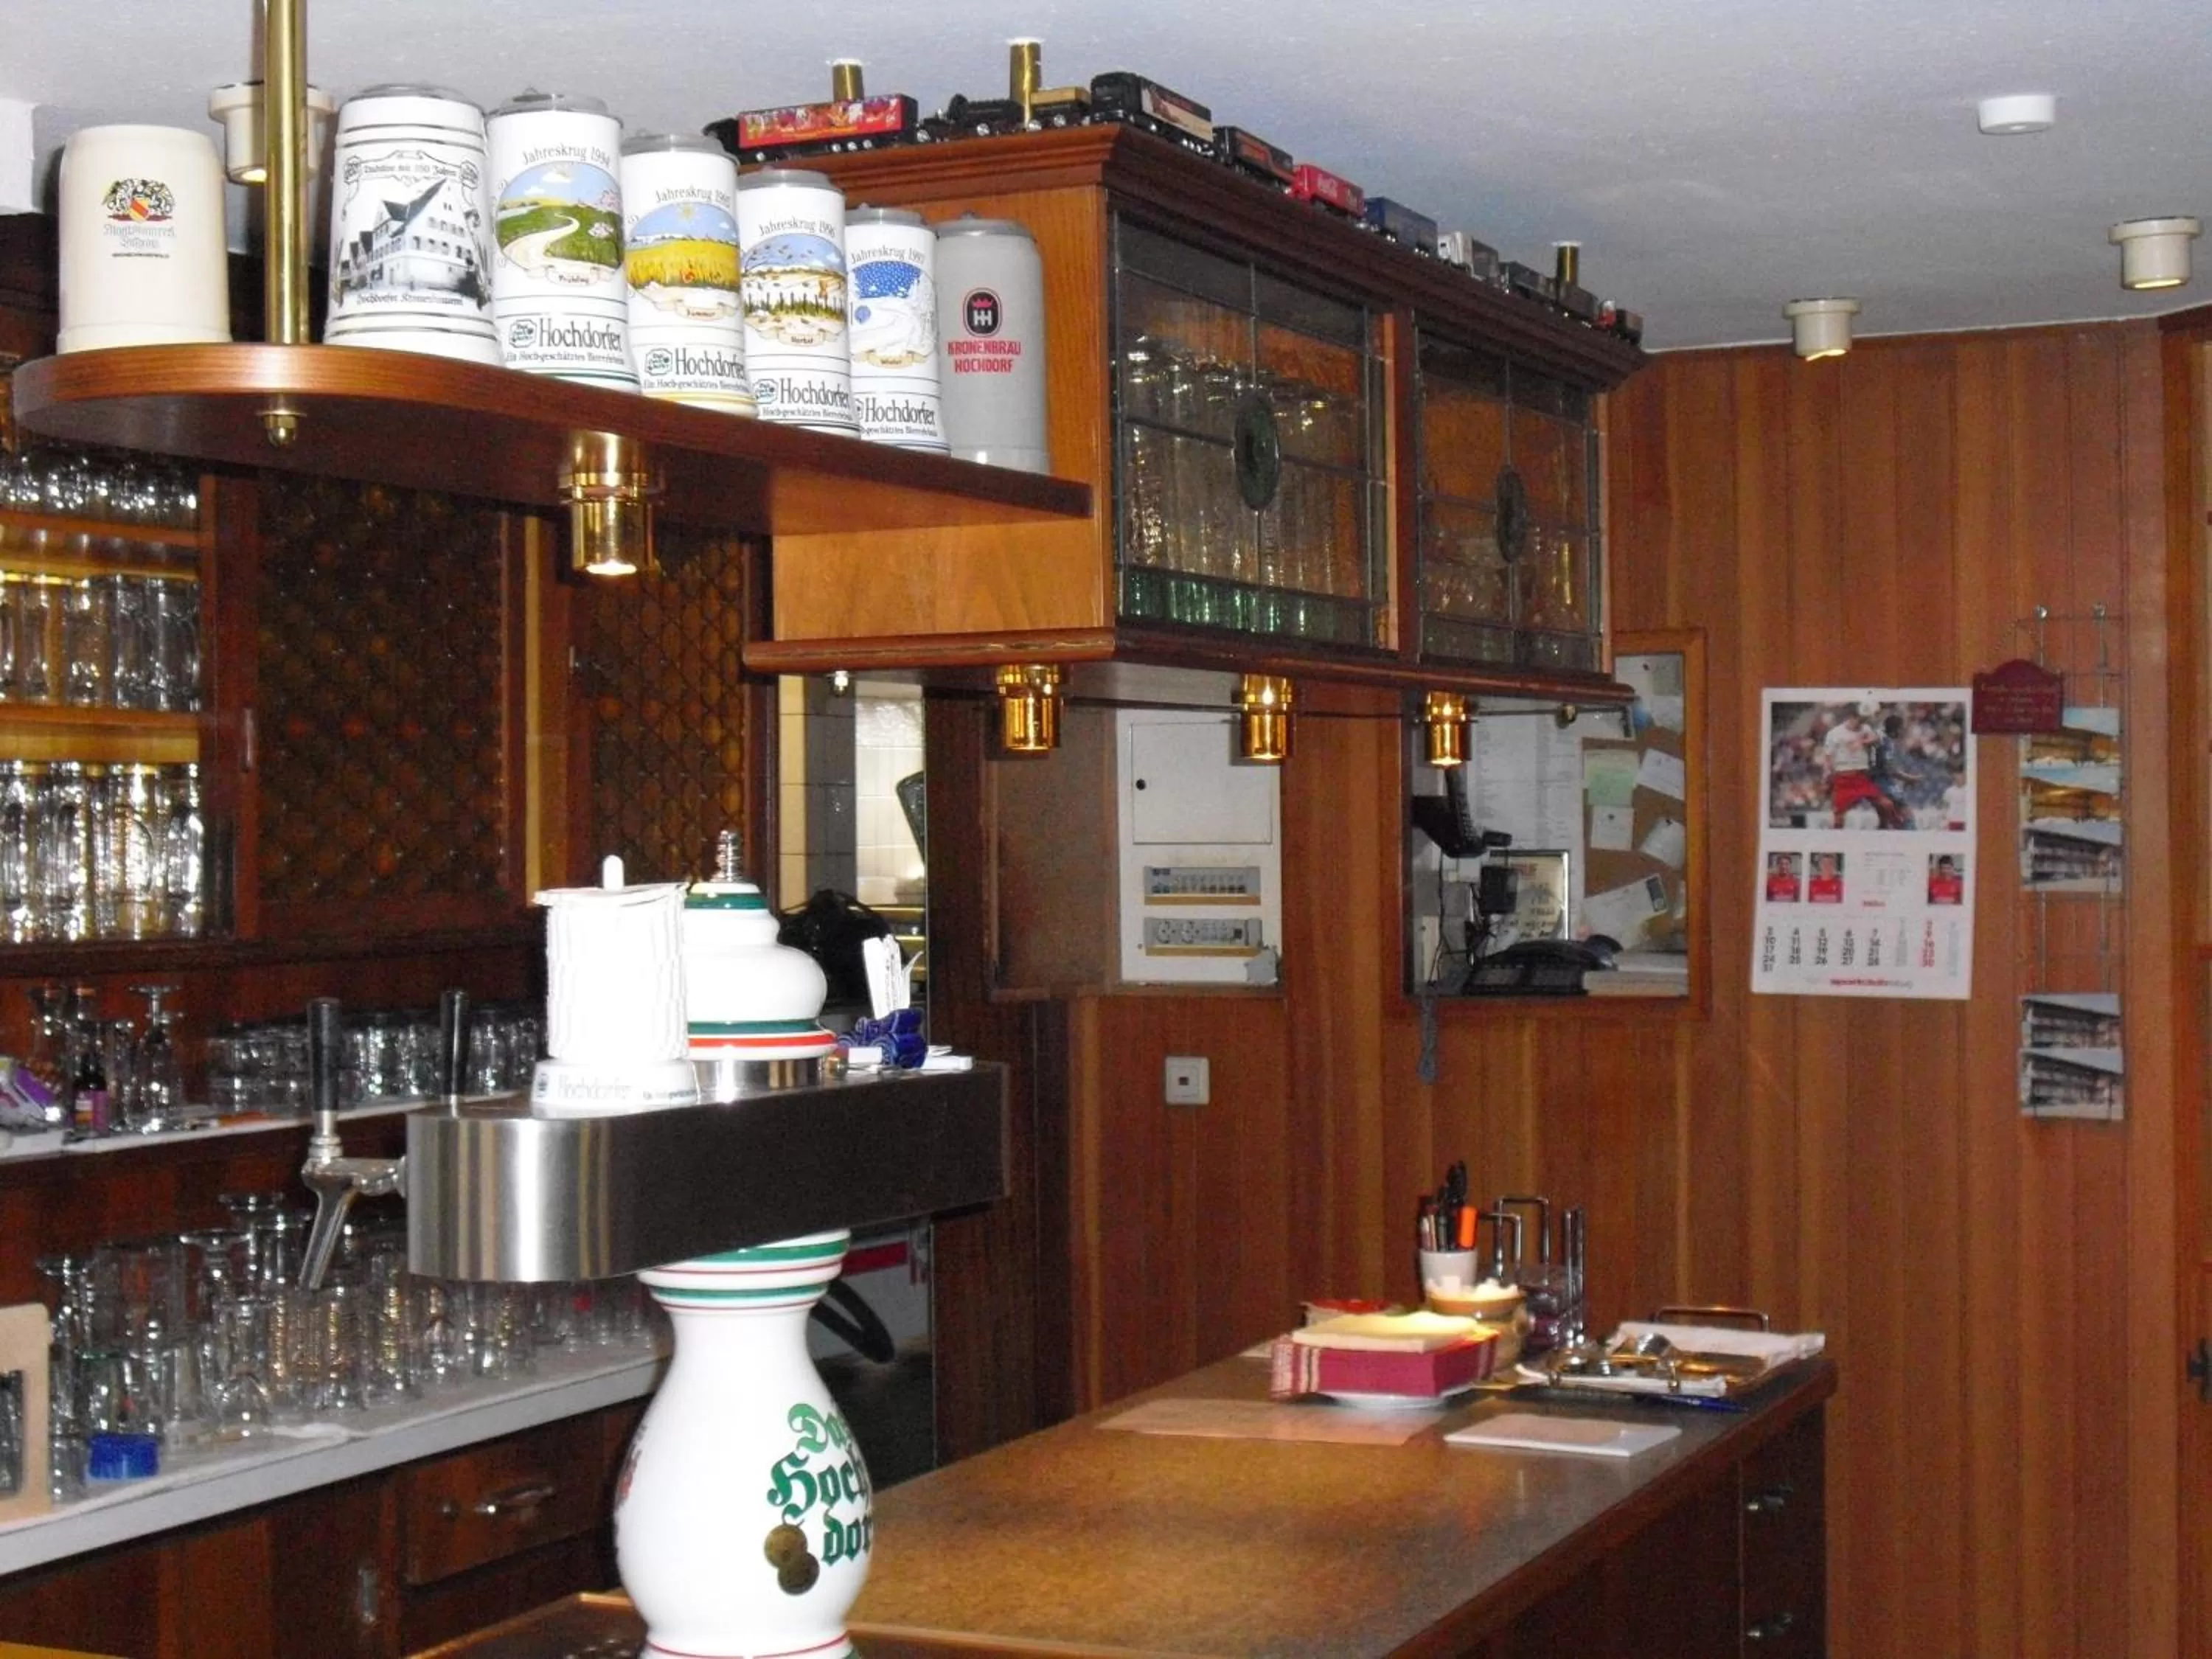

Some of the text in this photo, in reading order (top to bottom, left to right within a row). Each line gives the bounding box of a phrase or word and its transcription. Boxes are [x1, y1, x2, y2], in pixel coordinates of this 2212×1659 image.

[521, 142, 588, 165] Jahreskrug
[655, 184, 712, 204] Jahreskrug
[758, 215, 816, 237] Jahreskrug
[851, 244, 906, 265] Jahreskrug
[539, 317, 622, 352] Hochdorfer
[954, 358, 1015, 374] HOCHDORF
[779, 377, 850, 409] Hochdorfer
[865, 397, 936, 425] Hochdorfer
[787, 1403, 854, 1453] Da
[821, 1509, 872, 1566] dor
